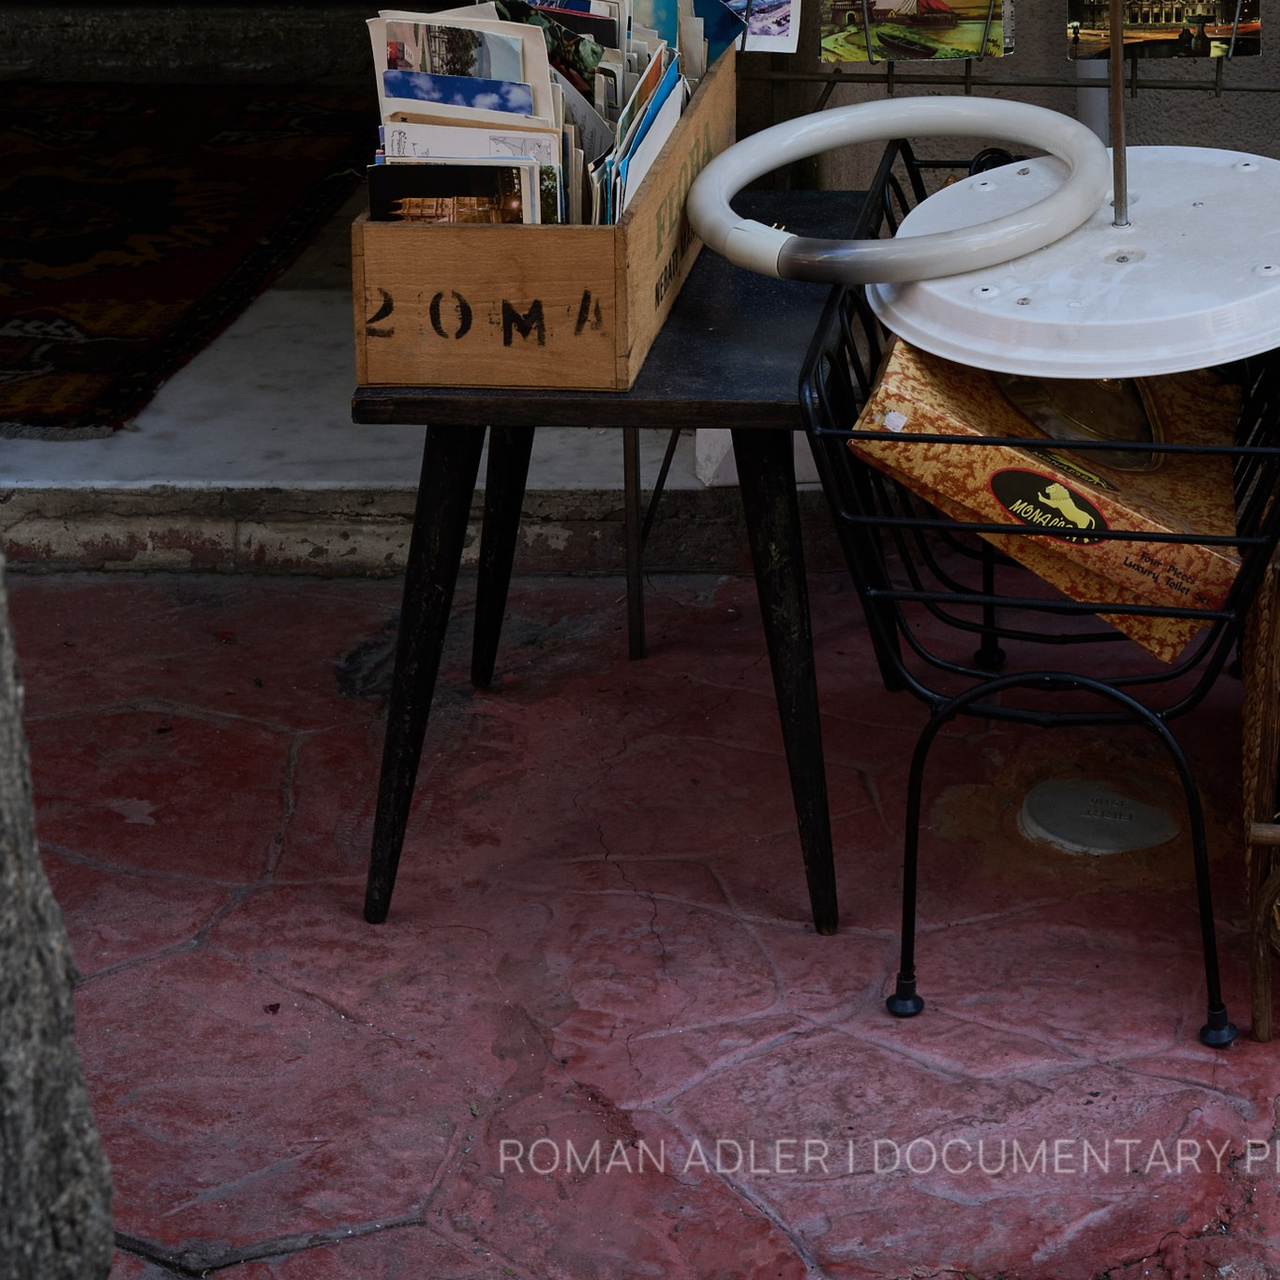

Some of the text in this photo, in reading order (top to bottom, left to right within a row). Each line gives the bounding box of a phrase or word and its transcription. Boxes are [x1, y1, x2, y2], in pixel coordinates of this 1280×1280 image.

[1122, 556, 1211, 605] Luxury Toilet Set
[1140, 551, 1196, 585] Four Pieces
